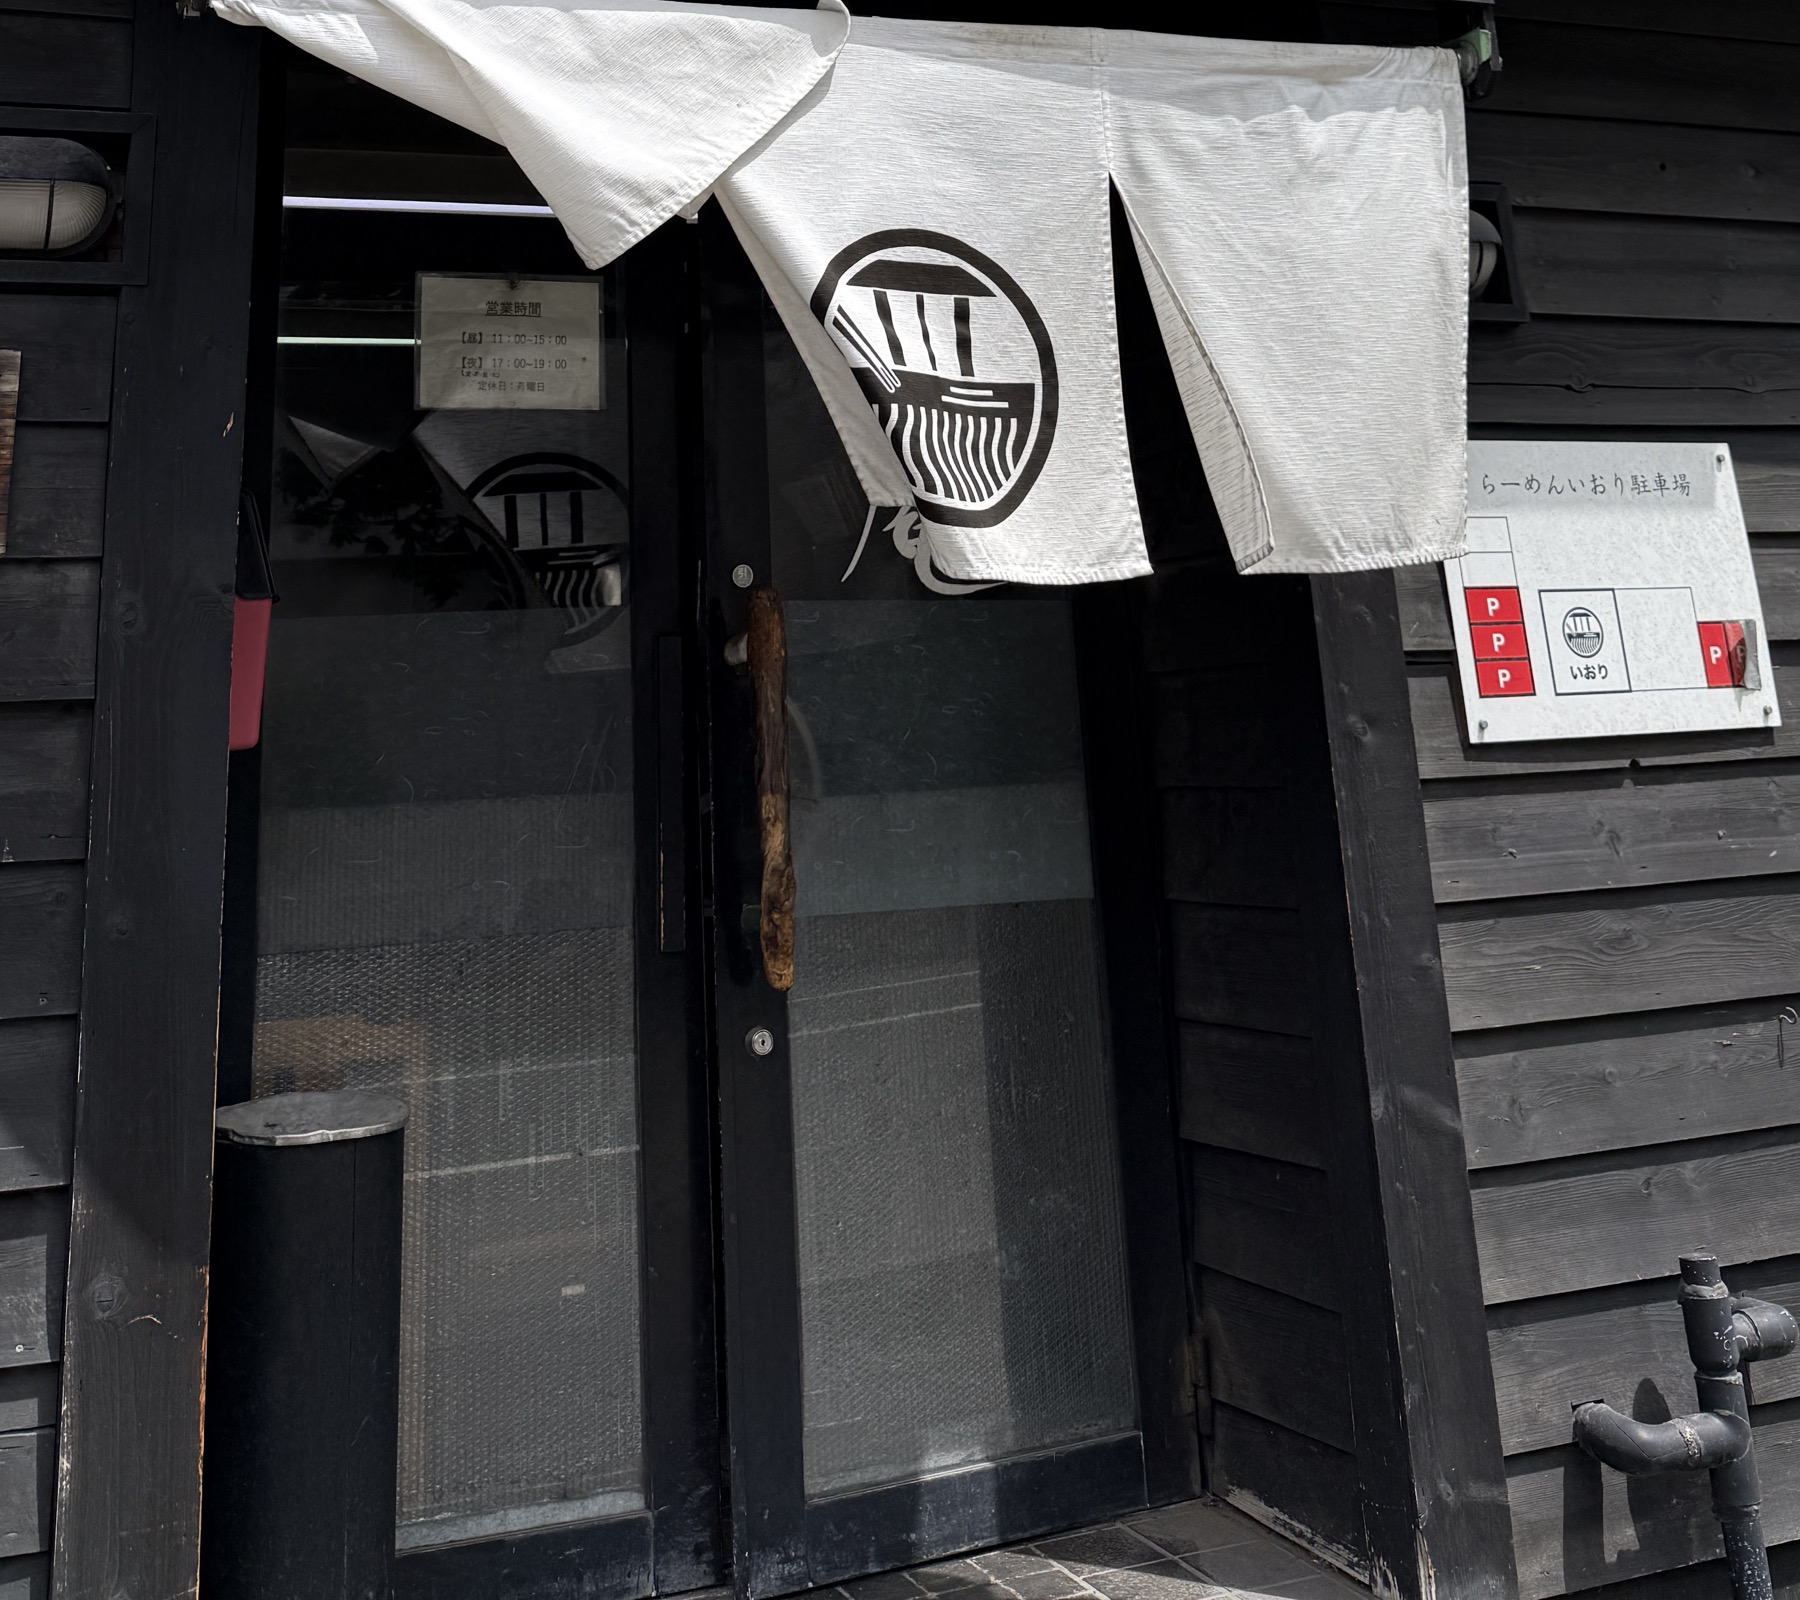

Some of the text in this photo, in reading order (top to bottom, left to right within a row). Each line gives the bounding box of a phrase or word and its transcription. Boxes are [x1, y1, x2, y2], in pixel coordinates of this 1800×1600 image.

[485, 300, 542, 317] 営業時間
[461, 331, 483, 344] 【昼】
[461, 356, 483, 370] 【夜】
[1481, 473, 1692, 498] らーめんいおり駐車場
[1486, 596, 1500, 617] P
[1492, 632, 1505, 653] P
[1709, 645, 1722, 665] P
[1497, 668, 1511, 689] P
[1569, 663, 1608, 680] いおり
